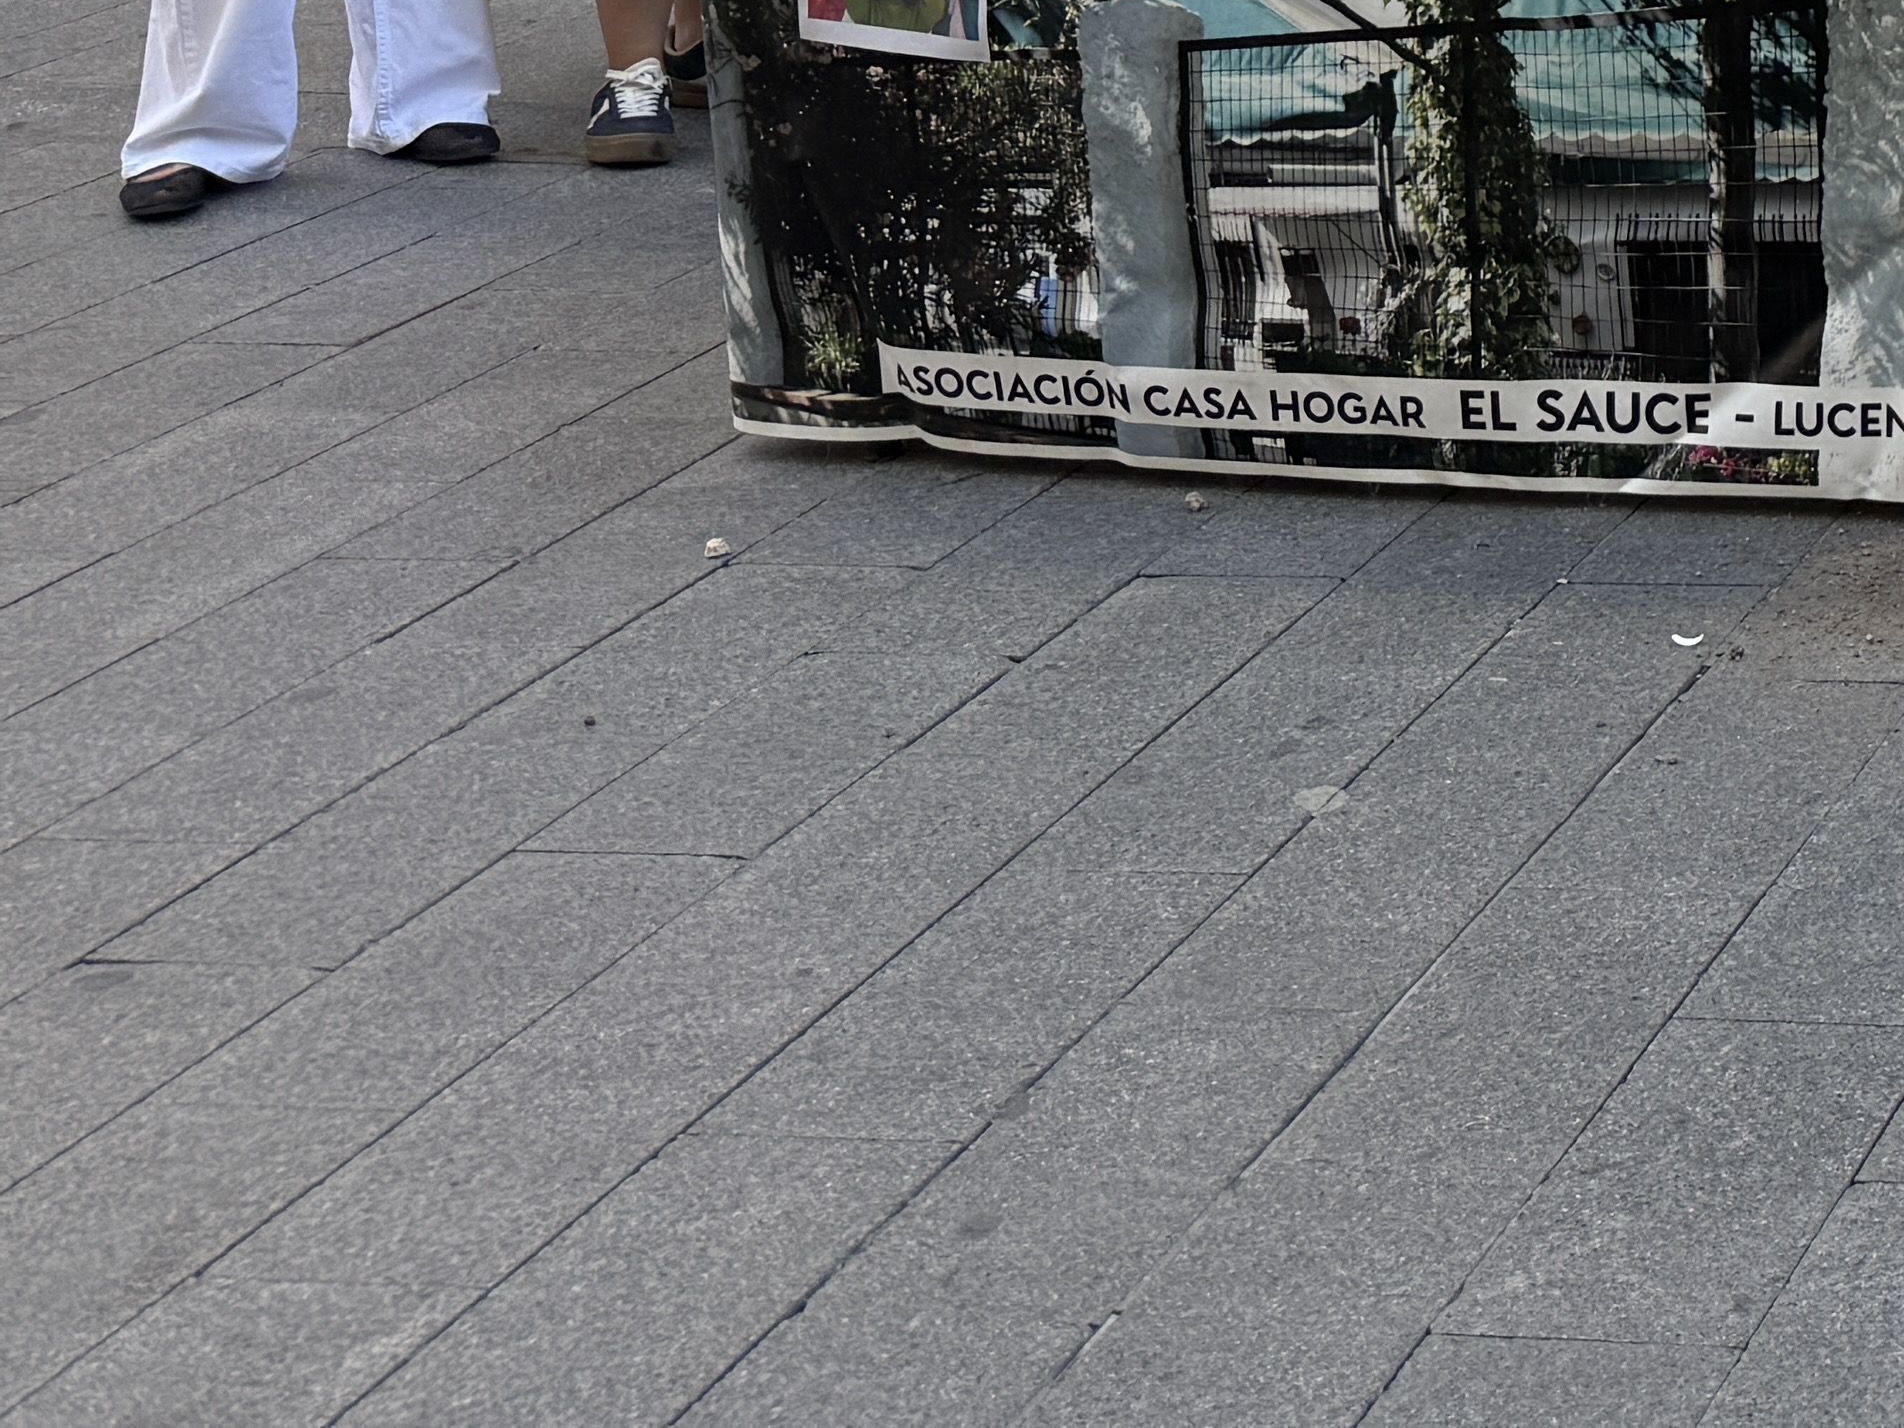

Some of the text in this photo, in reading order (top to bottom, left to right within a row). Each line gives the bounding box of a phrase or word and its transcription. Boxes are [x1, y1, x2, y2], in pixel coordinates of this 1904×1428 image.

[897, 362, 1130, 414] ASOCIACIÓN
[1144, 385, 1256, 421] CASA
[1270, 389, 1426, 429] HOGAR
[1459, 389, 1517, 431] EL
[1536, 390, 1711, 436] SAUCE
